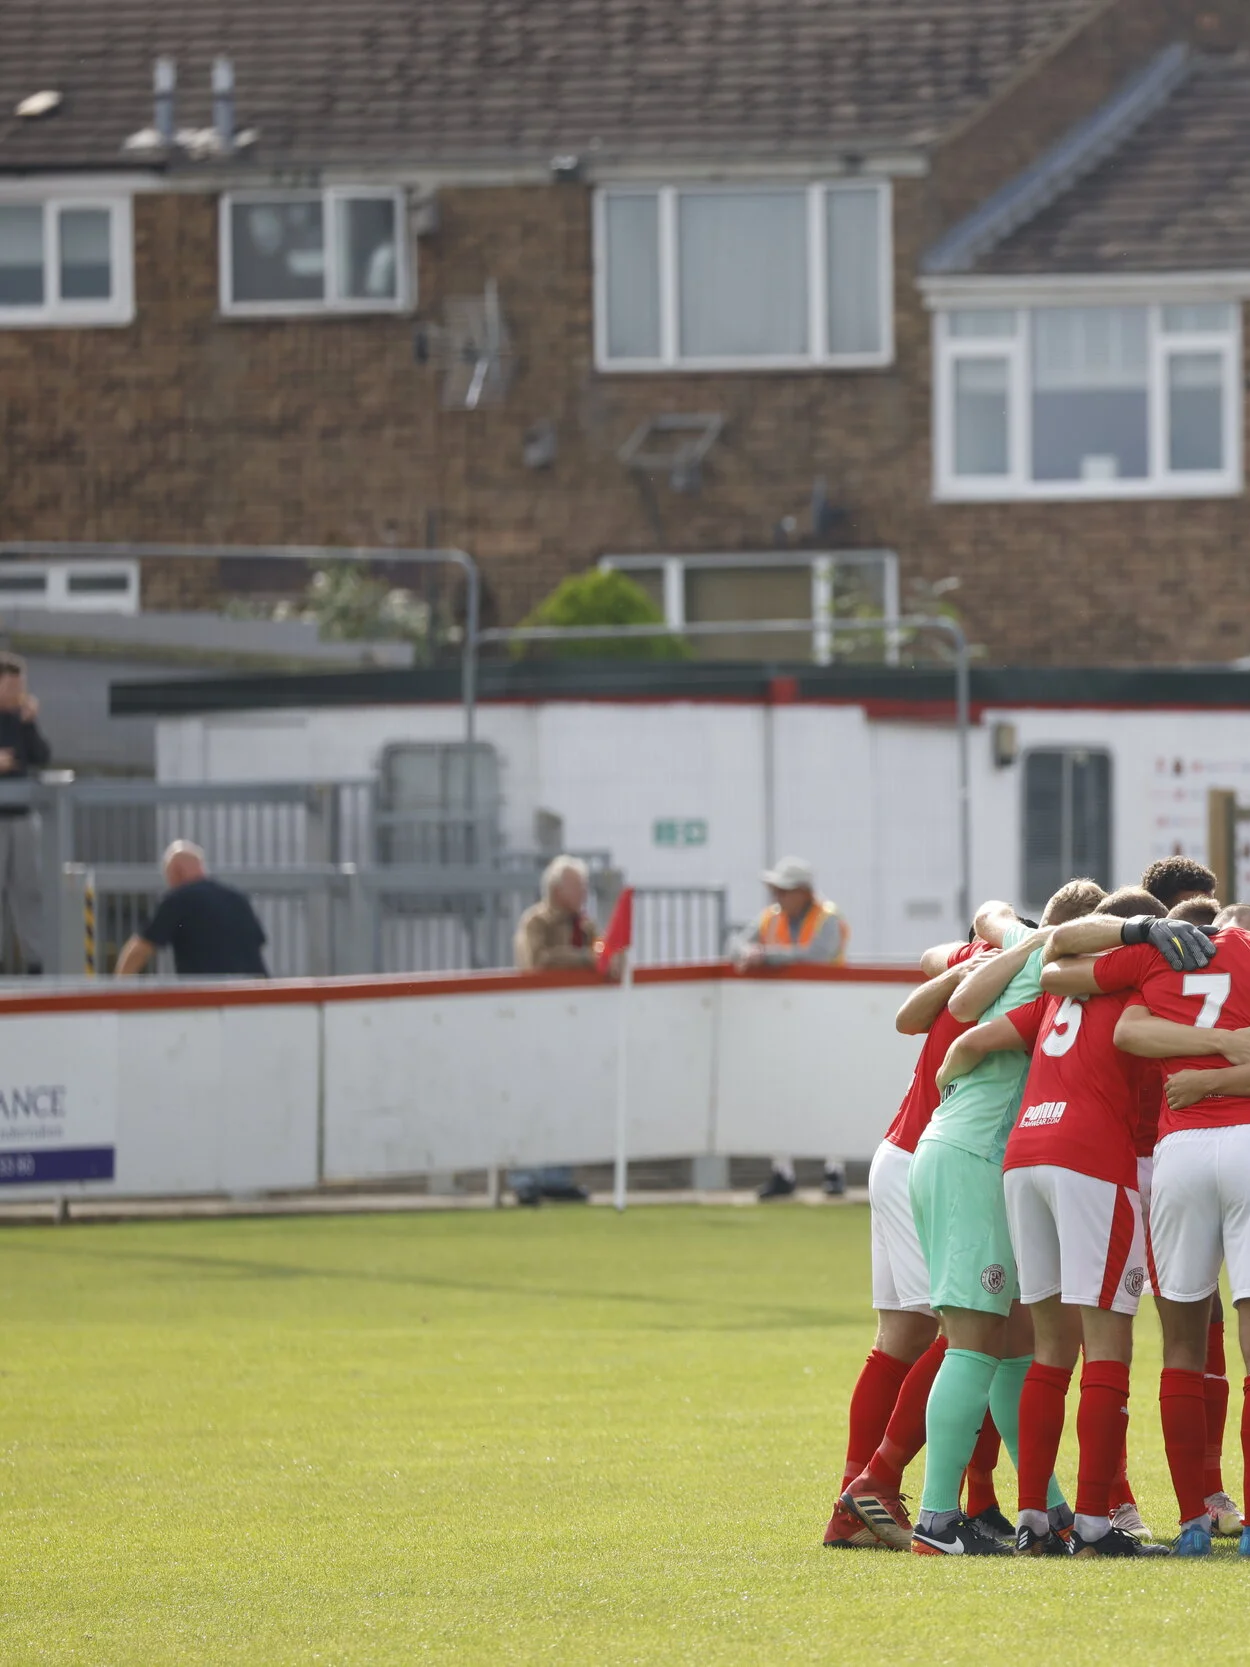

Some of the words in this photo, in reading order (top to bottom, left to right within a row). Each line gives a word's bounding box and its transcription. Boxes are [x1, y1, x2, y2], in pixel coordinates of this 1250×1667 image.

[1041, 994, 1090, 1057] 5
[1182, 973, 1231, 1028] 7
[1021, 1101, 1067, 1121] PUMA
